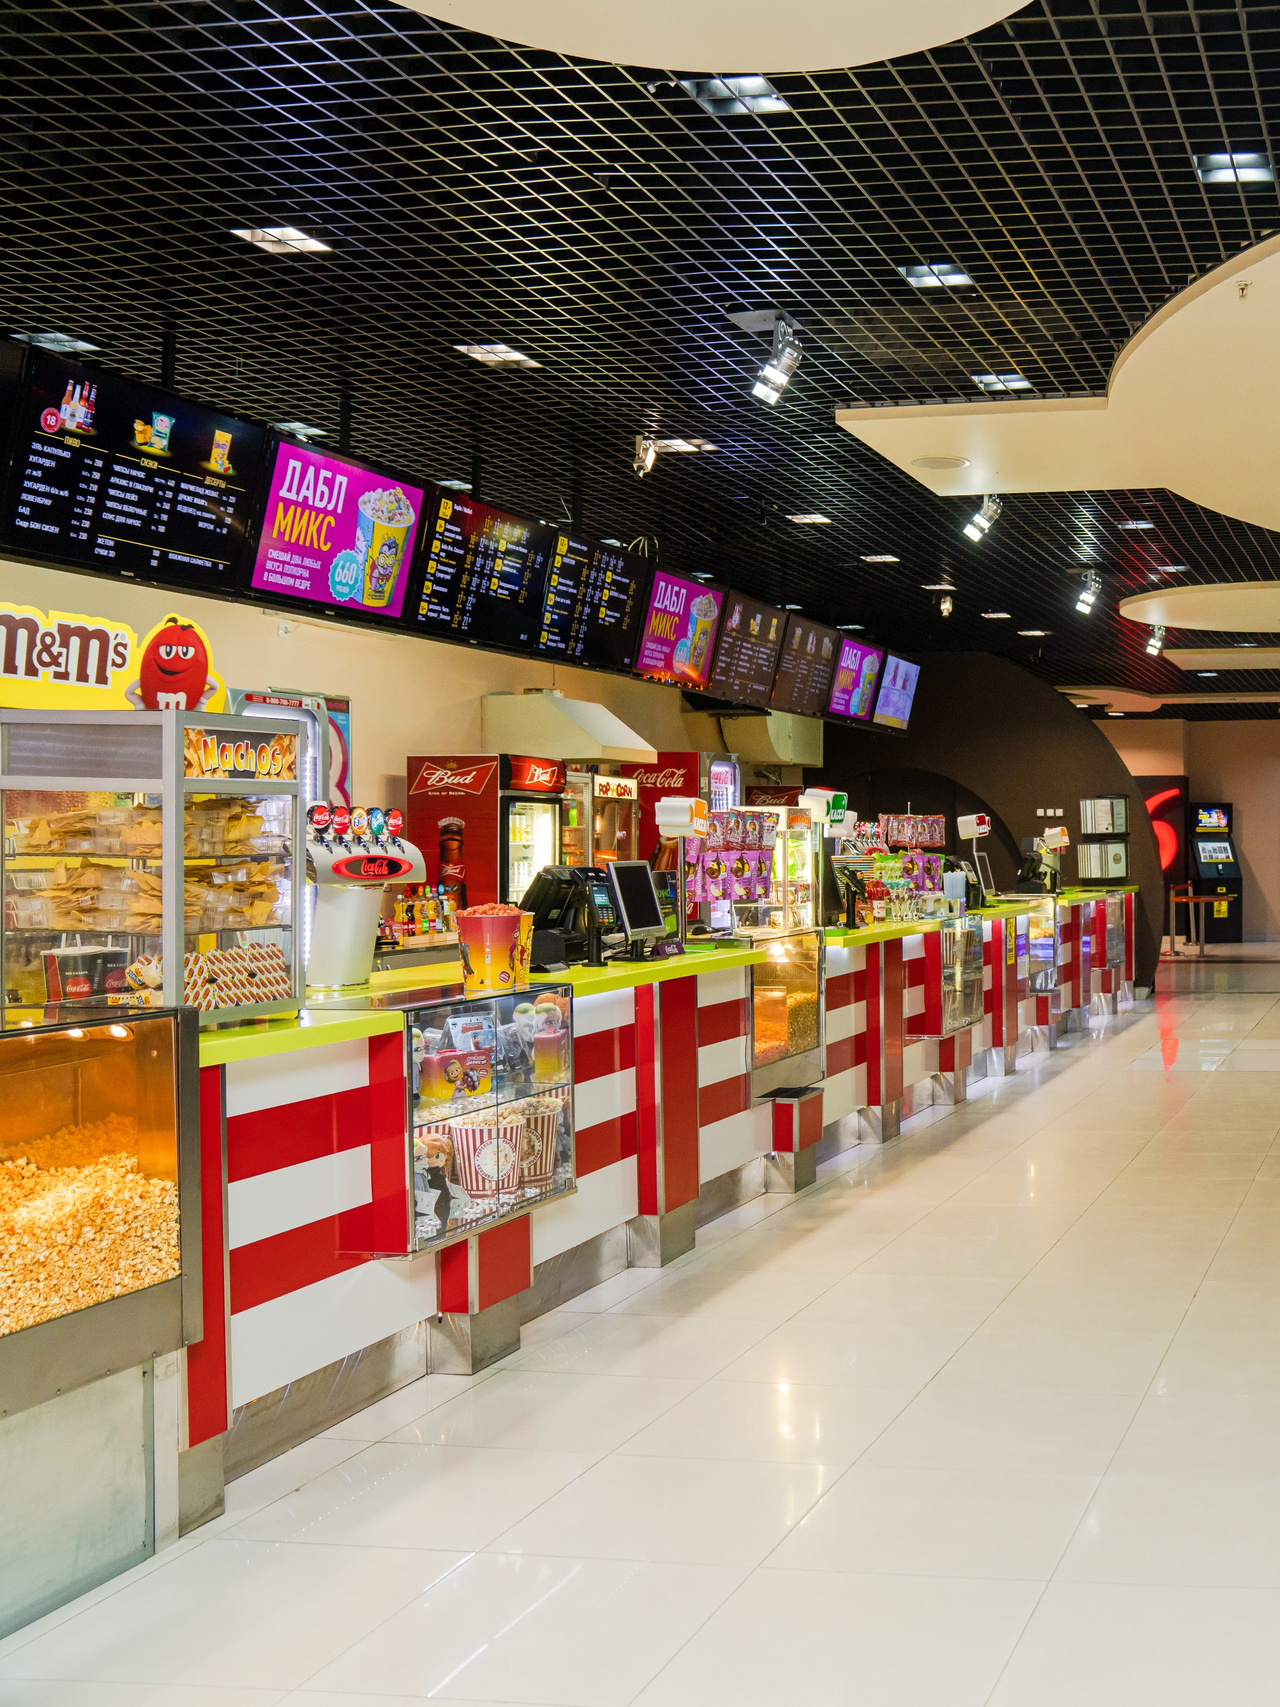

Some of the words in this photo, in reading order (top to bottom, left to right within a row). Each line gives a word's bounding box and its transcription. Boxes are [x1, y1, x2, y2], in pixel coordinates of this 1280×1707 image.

[46, 414, 57, 426] 18
[279, 458, 347, 513] ДАБЛ
[272, 501, 335, 551] МИКС
[268, 547, 290, 560] СМЕШАЙ
[290, 555, 302, 565] ДВА
[302, 558, 320, 568] ЛЮБЫХ
[265, 560, 282, 571] ВКУСА
[283, 564, 309, 577] ПОПКОРНА
[334, 560, 356, 584] 660
[268, 573, 294, 585] БОЛЬШОМ
[294, 579, 310, 589] ВЕДРЕ
[654, 580, 685, 614] ДАБЛ
[649, 610, 678, 640] МИКС
[841, 646, 860, 669] ДАБЛ
[837, 669, 855, 689] МИКС
[201, 735, 282, 775] Nachos
[423, 770, 476, 786] Bud
[533, 768, 550, 781] Bud
[632, 768, 687, 788] Coca-Cola
[599, 782, 610, 796] POP
[616, 783, 632, 797] CORN
[752, 795, 787, 805] Bud
[361, 859, 388, 875] Coca-Cola
[66, 984, 89, 992] Coca-Cola
